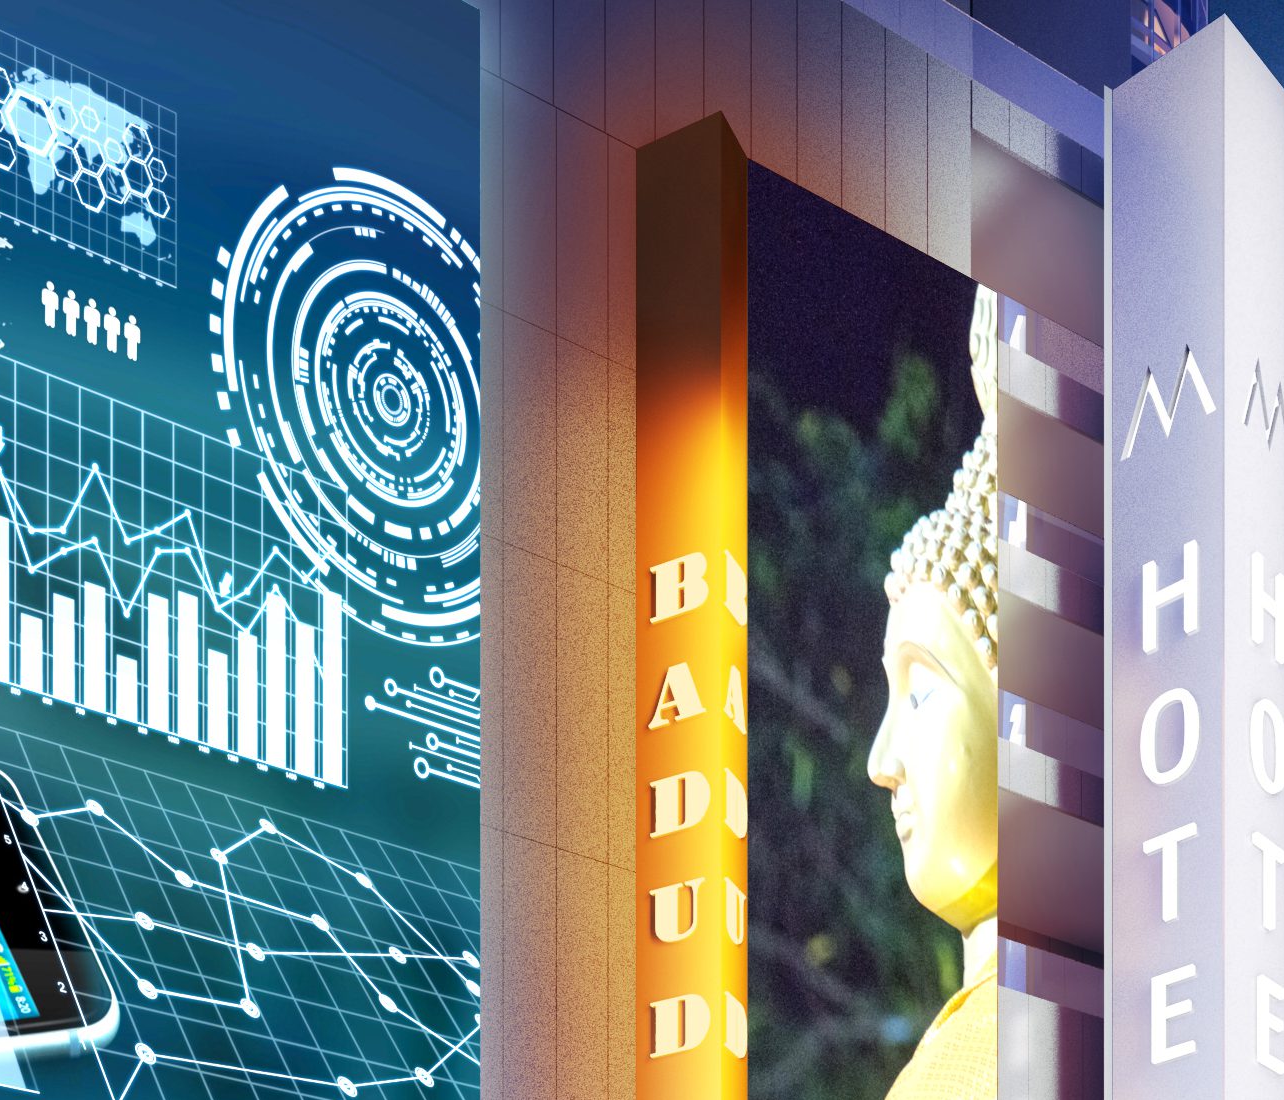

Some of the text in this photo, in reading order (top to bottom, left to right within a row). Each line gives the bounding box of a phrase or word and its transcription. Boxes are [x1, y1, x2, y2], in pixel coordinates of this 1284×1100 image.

[649, 551, 711, 1059] BADUD
[3, 834, 12, 845] 5
[38, 930, 48, 942] 3
[57, 981, 67, 994] 2
